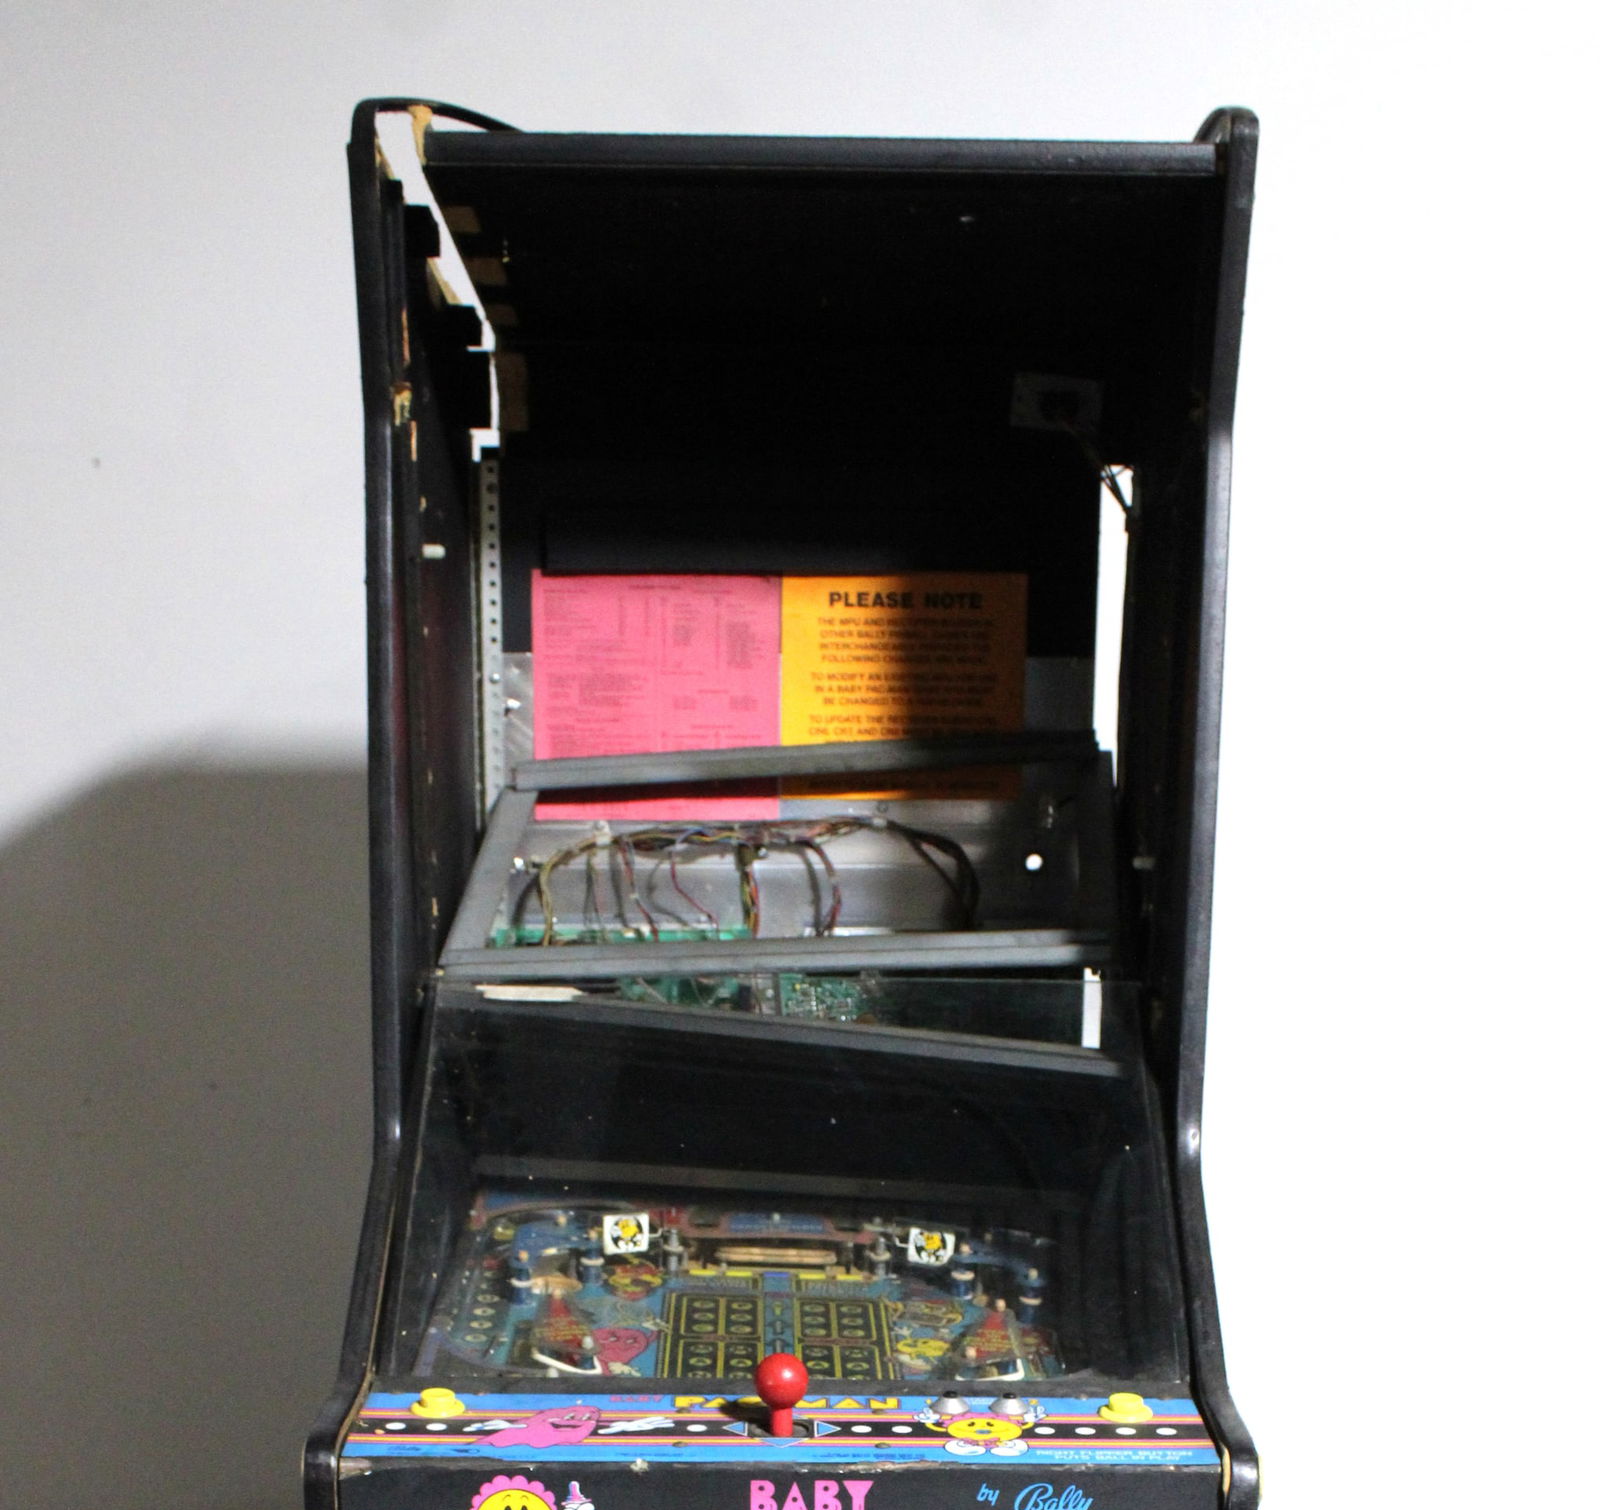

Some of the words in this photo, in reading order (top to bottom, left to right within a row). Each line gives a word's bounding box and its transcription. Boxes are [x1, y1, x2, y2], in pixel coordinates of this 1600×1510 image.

[828, 591, 914, 609] PLEASE
[924, 592, 984, 609] NOTE
[977, 1483, 999, 1506] by
